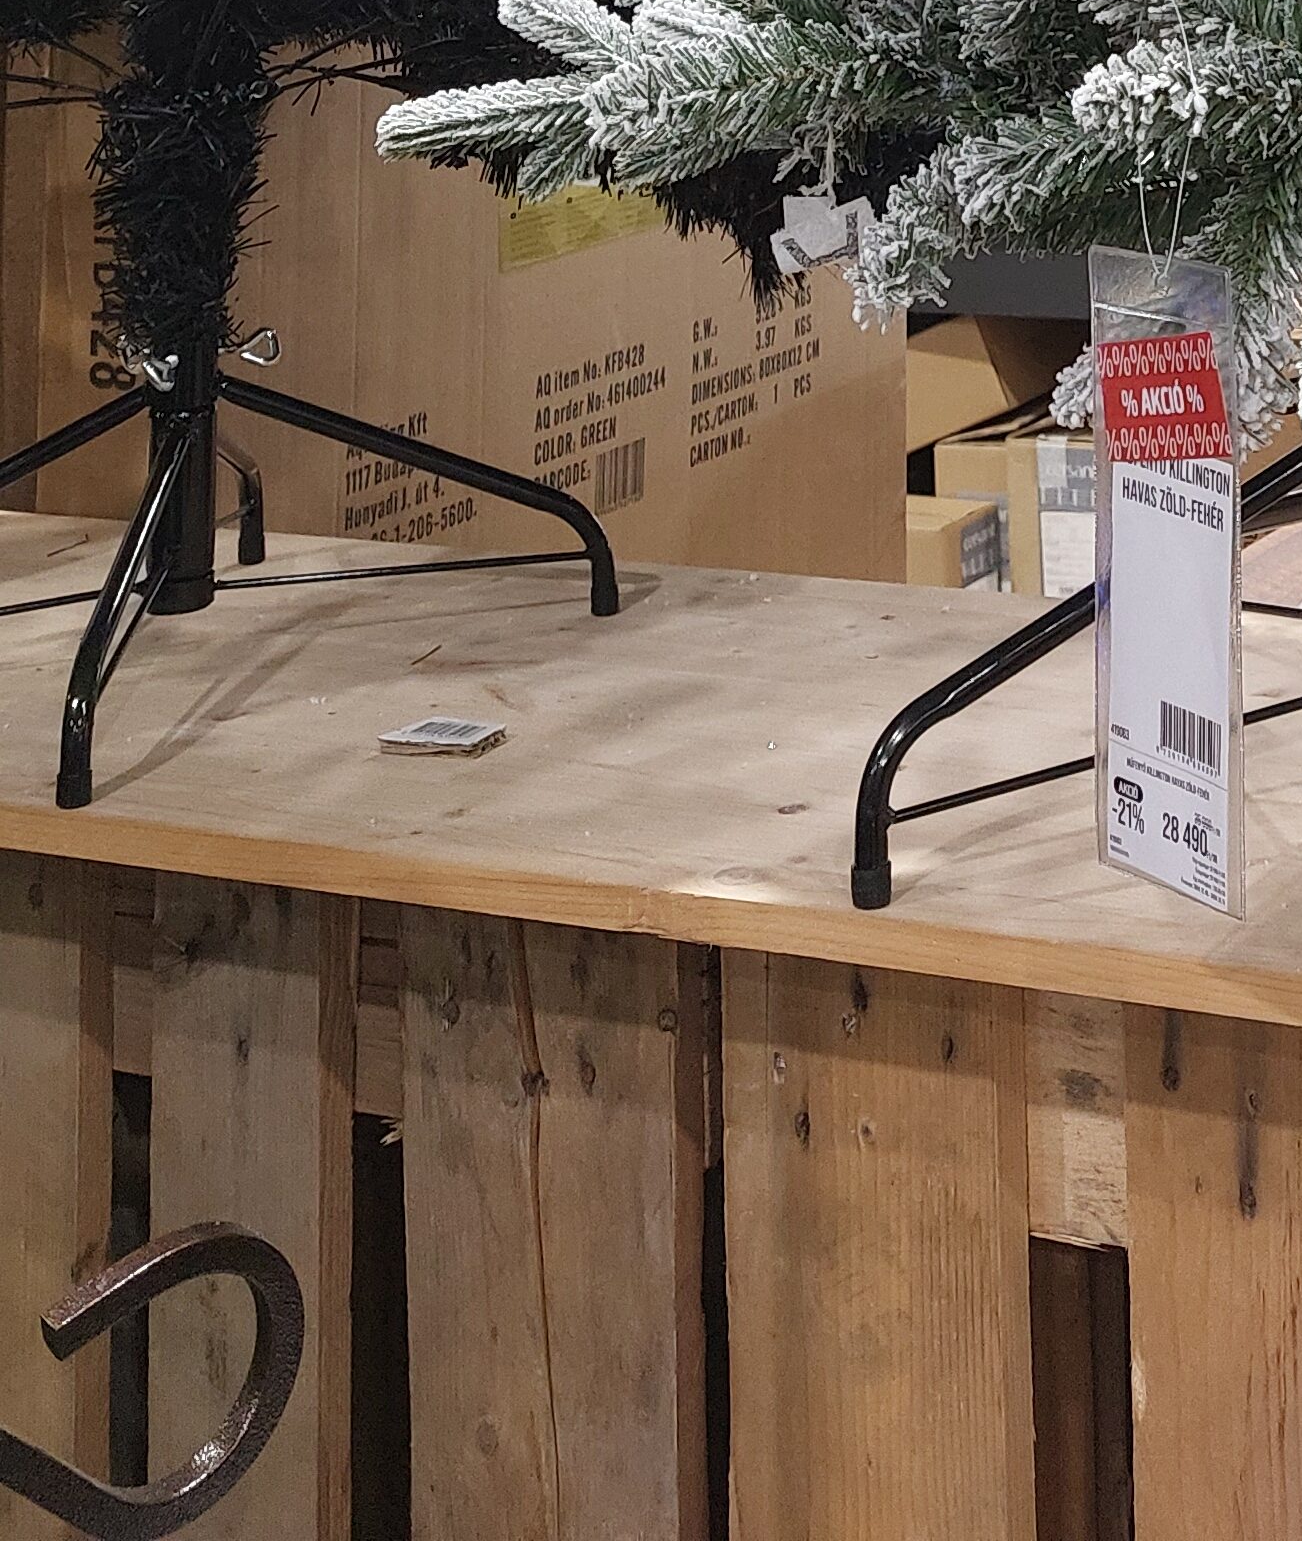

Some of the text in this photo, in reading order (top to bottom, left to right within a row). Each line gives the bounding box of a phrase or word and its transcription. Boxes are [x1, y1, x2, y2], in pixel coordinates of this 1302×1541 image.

[755, 325, 776, 352] 3.97
[794, 313, 812, 339] KGS
[535, 343, 646, 399] AQ item No: KFB428
[691, 363, 757, 406] DIMENSIONS:
[806, 337, 821, 362] CM
[773, 383, 779, 405] 1
[793, 373, 812, 399] PCS
[534, 365, 667, 433] AQ order No: 461400244
[1141, 378, 1185, 416] AKCIÓ
[408, 411, 428, 438] Kft
[534, 415, 617, 466] COLOR: GREEN
[689, 433, 729, 468] CARTON
[345, 460, 420, 496] 1117 Budap
[534, 459, 591, 489] ARCODE:
[1122, 476, 1157, 508] HAVAS
[1169, 458, 1231, 497] KILLINGTON
[344, 490, 399, 532] Hunyadi
[1118, 779, 1139, 798] AKCIÓ
[1111, 797, 1145, 835] -21%
[1162, 811, 1180, 844] 28
[1182, 821, 1208, 858] 490
